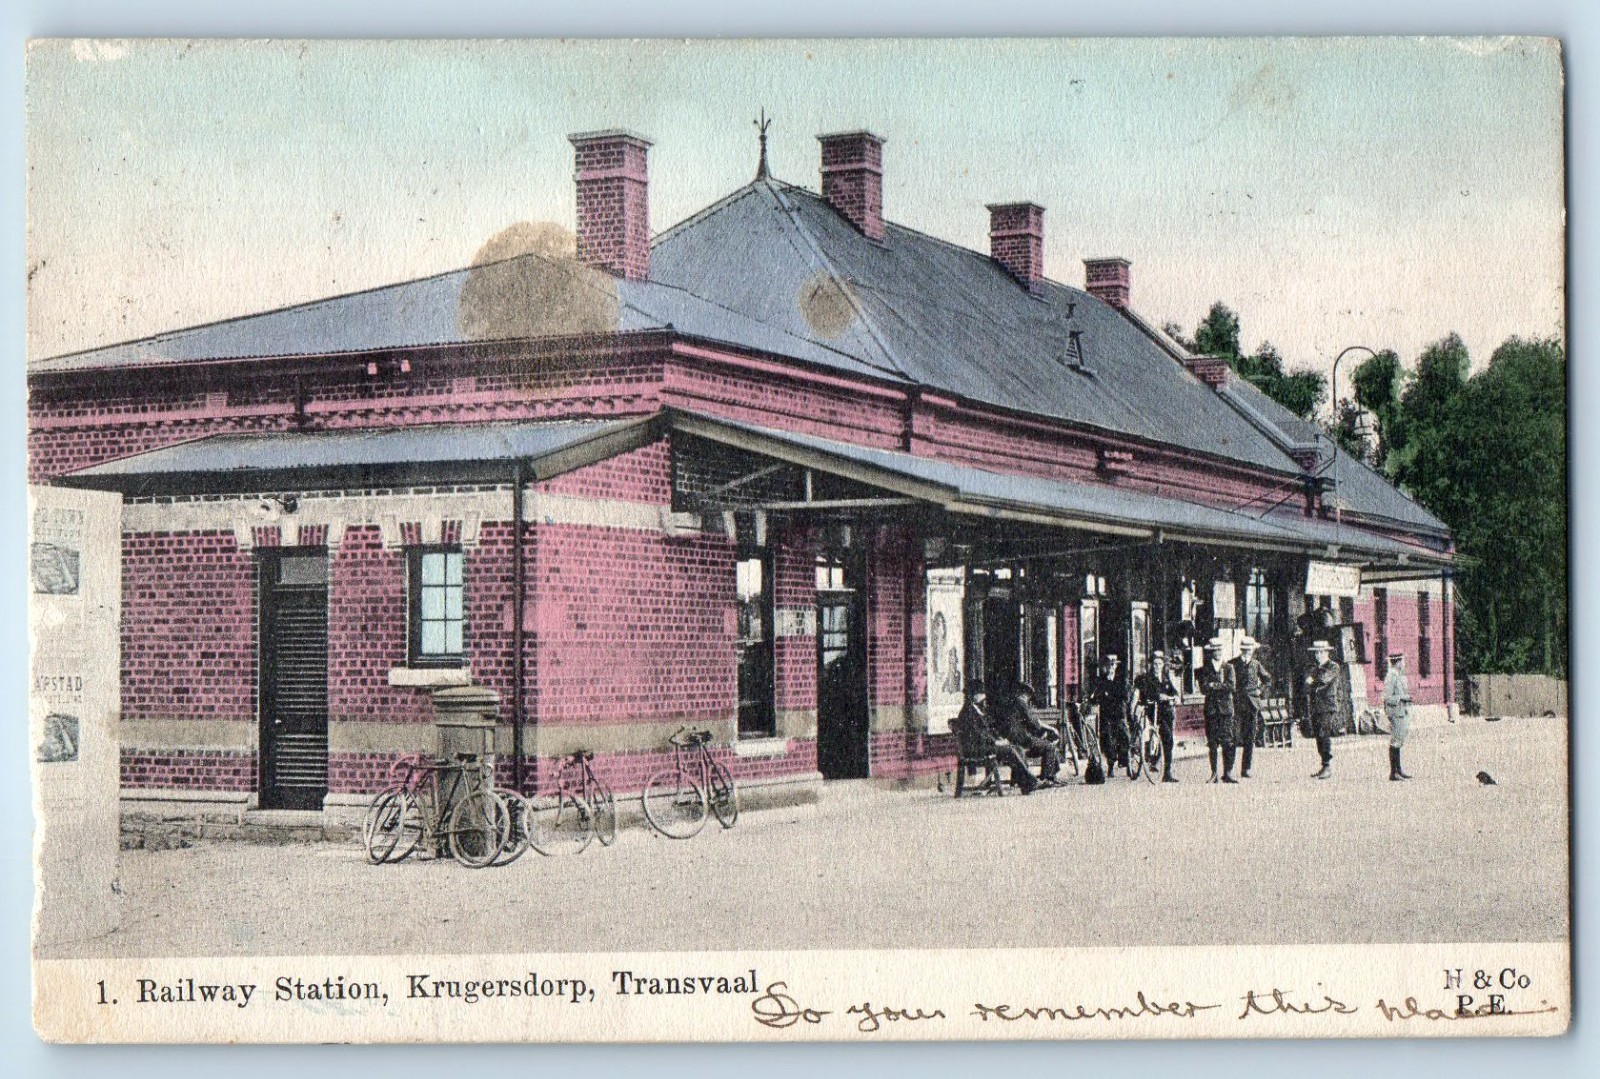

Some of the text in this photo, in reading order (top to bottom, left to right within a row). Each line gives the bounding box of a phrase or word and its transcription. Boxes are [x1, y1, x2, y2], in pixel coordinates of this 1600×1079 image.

[751, 981, 832, 1028] Do
[970, 991, 1221, 1021] remember
[1238, 983, 1357, 1019] this
